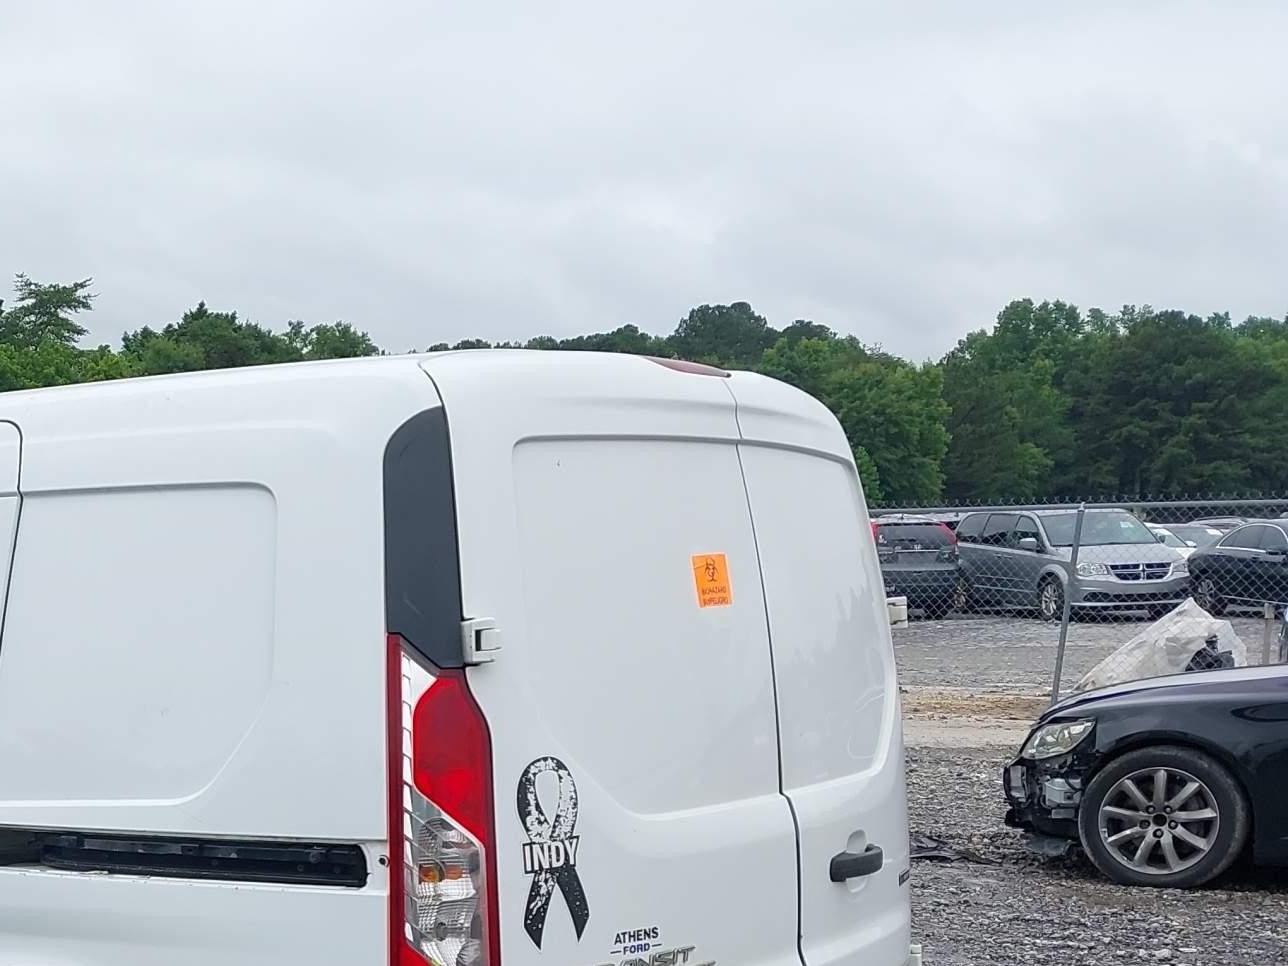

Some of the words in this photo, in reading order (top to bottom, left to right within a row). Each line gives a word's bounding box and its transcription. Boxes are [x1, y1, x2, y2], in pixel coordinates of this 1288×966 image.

[523, 836, 579, 874] INDY
[614, 926, 659, 945] ATHENS
[623, 942, 650, 955] FORD
